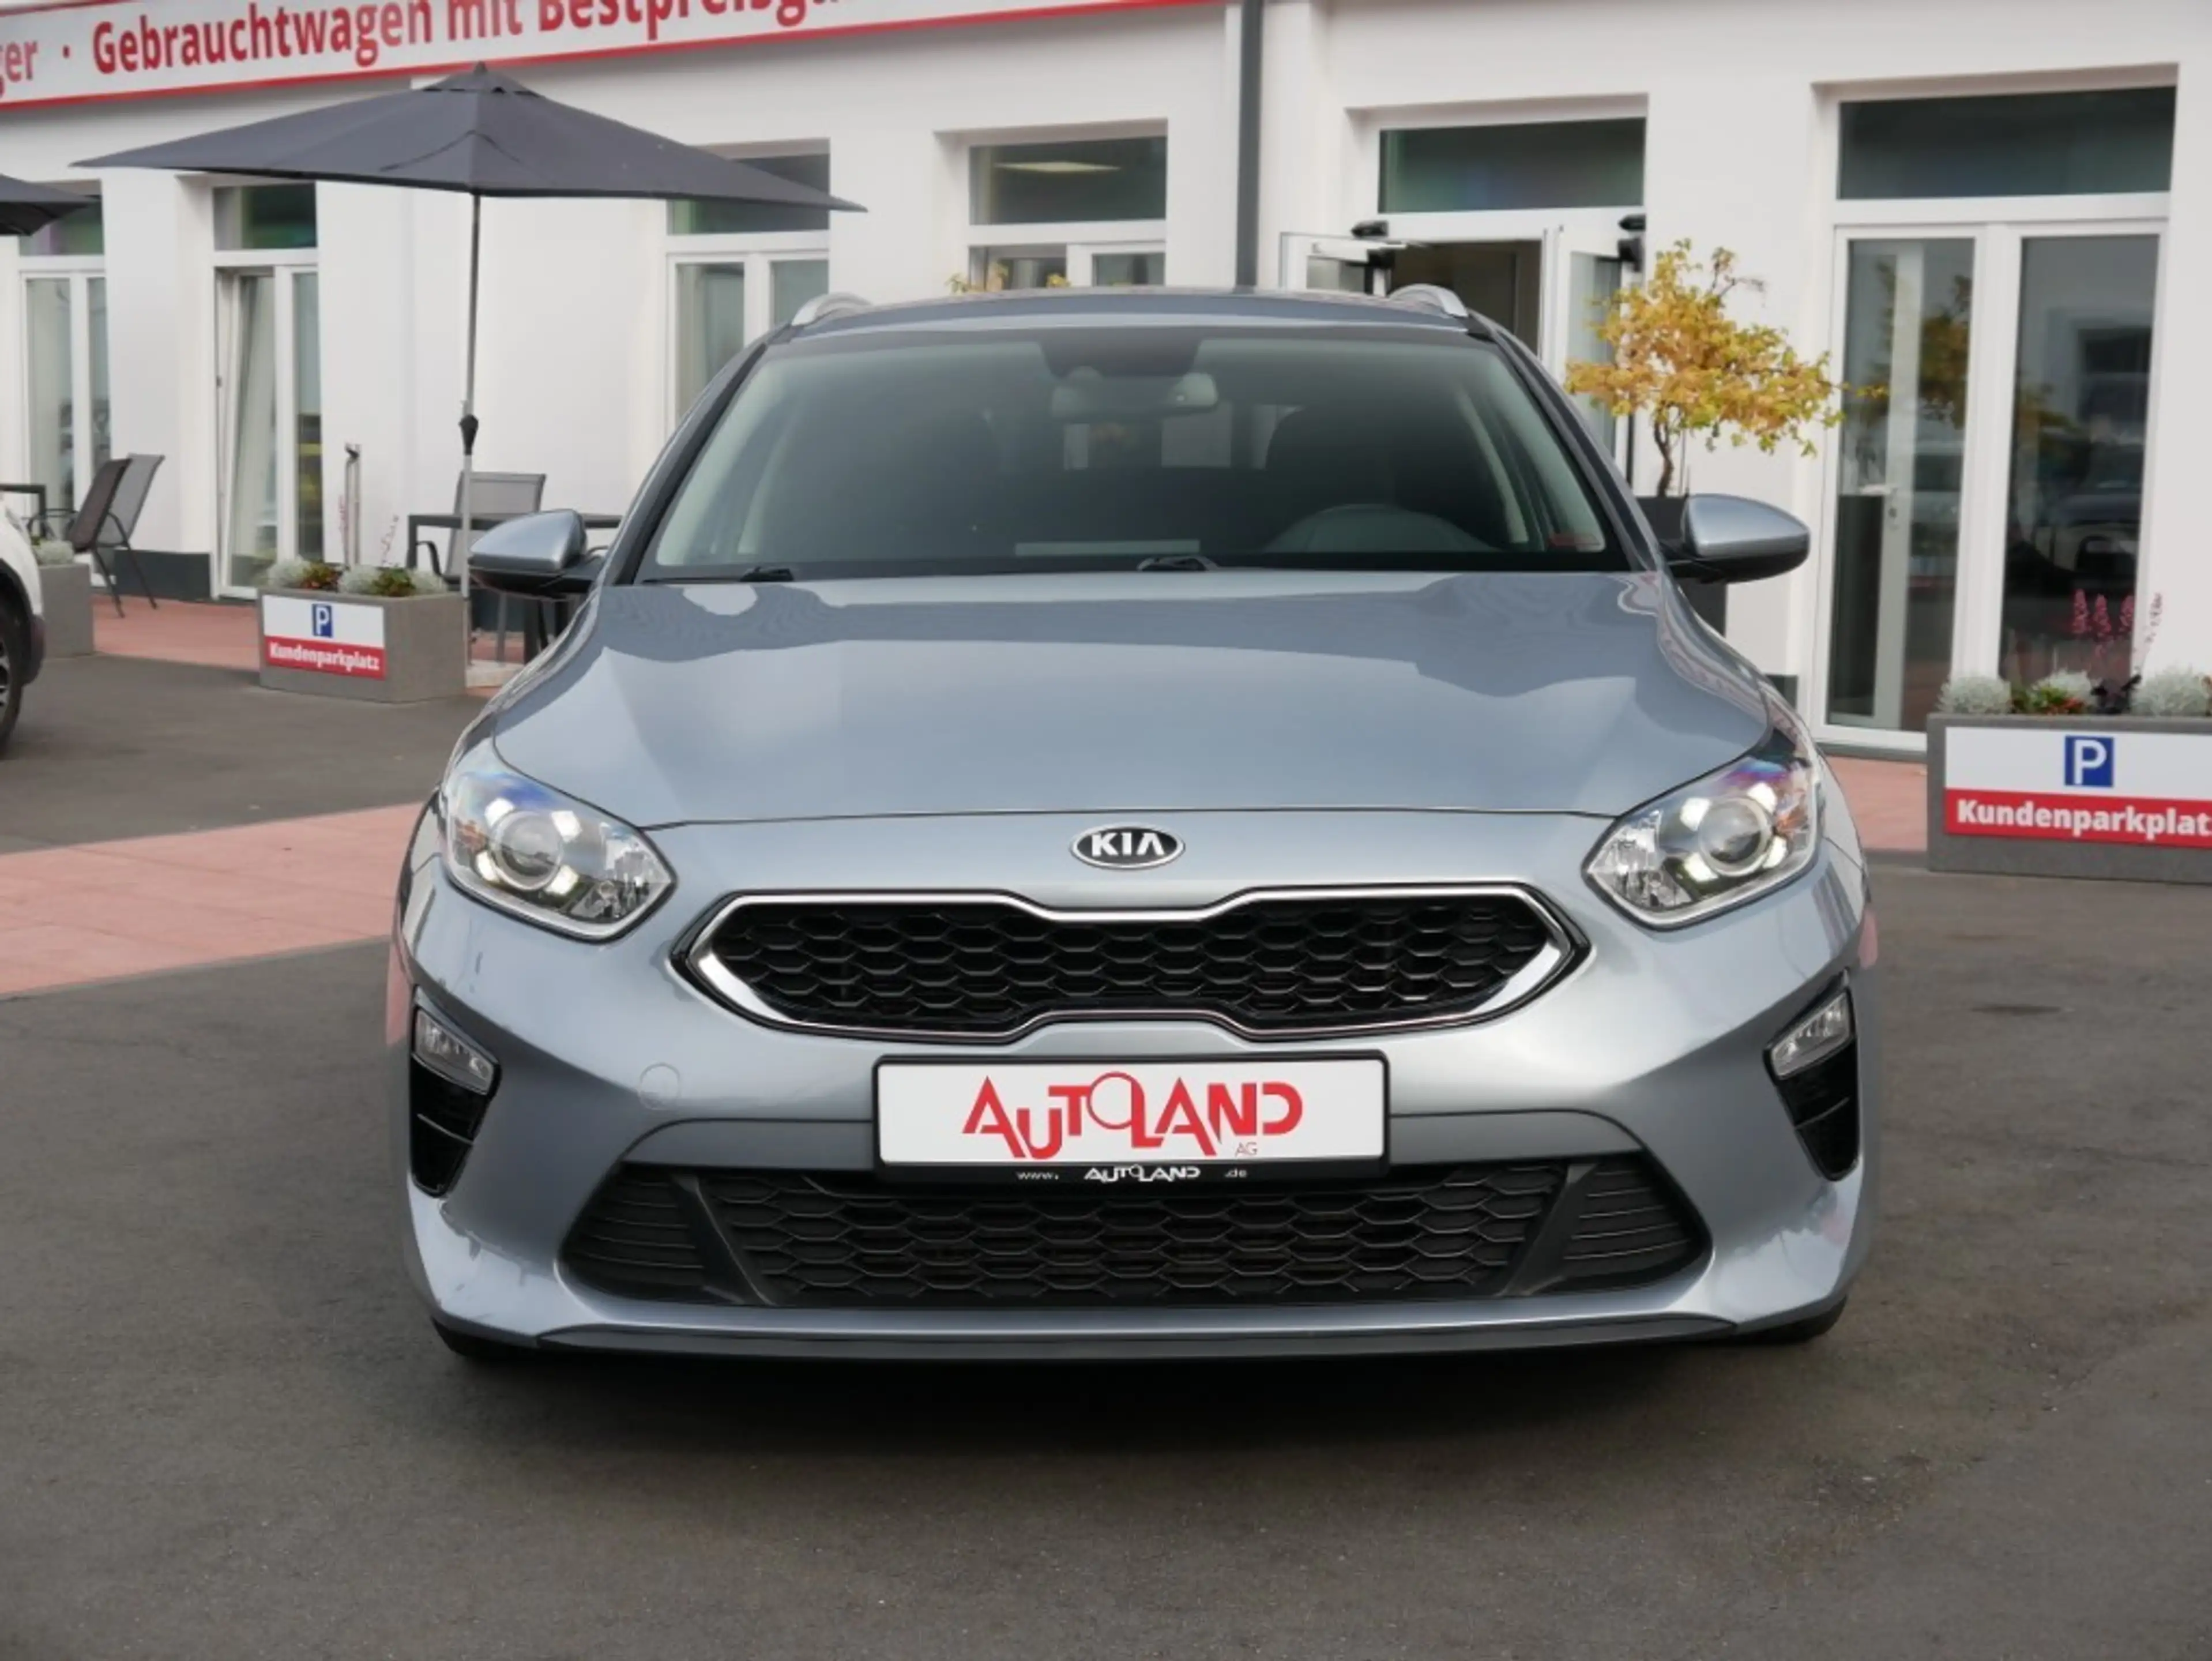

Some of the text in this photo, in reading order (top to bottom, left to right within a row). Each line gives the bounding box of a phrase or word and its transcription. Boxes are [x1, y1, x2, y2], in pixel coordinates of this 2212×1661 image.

[0, 40, 37, 97] er
[93, 0, 431, 74] Gebrauchtwagen
[317, 607, 330, 635] P
[269, 642, 381, 671] Kundenparkplatz
[2074, 739, 2107, 784] P
[1957, 799, 2212, 841] Kundenparkplat
[1092, 832, 1165, 856] KIA
[962, 1072, 1303, 1160] AUTOLAND
[1235, 1141, 1258, 1157] AG
[1017, 1171, 1059, 1181] www.
[1084, 1164, 1201, 1183] AUTOLAND
